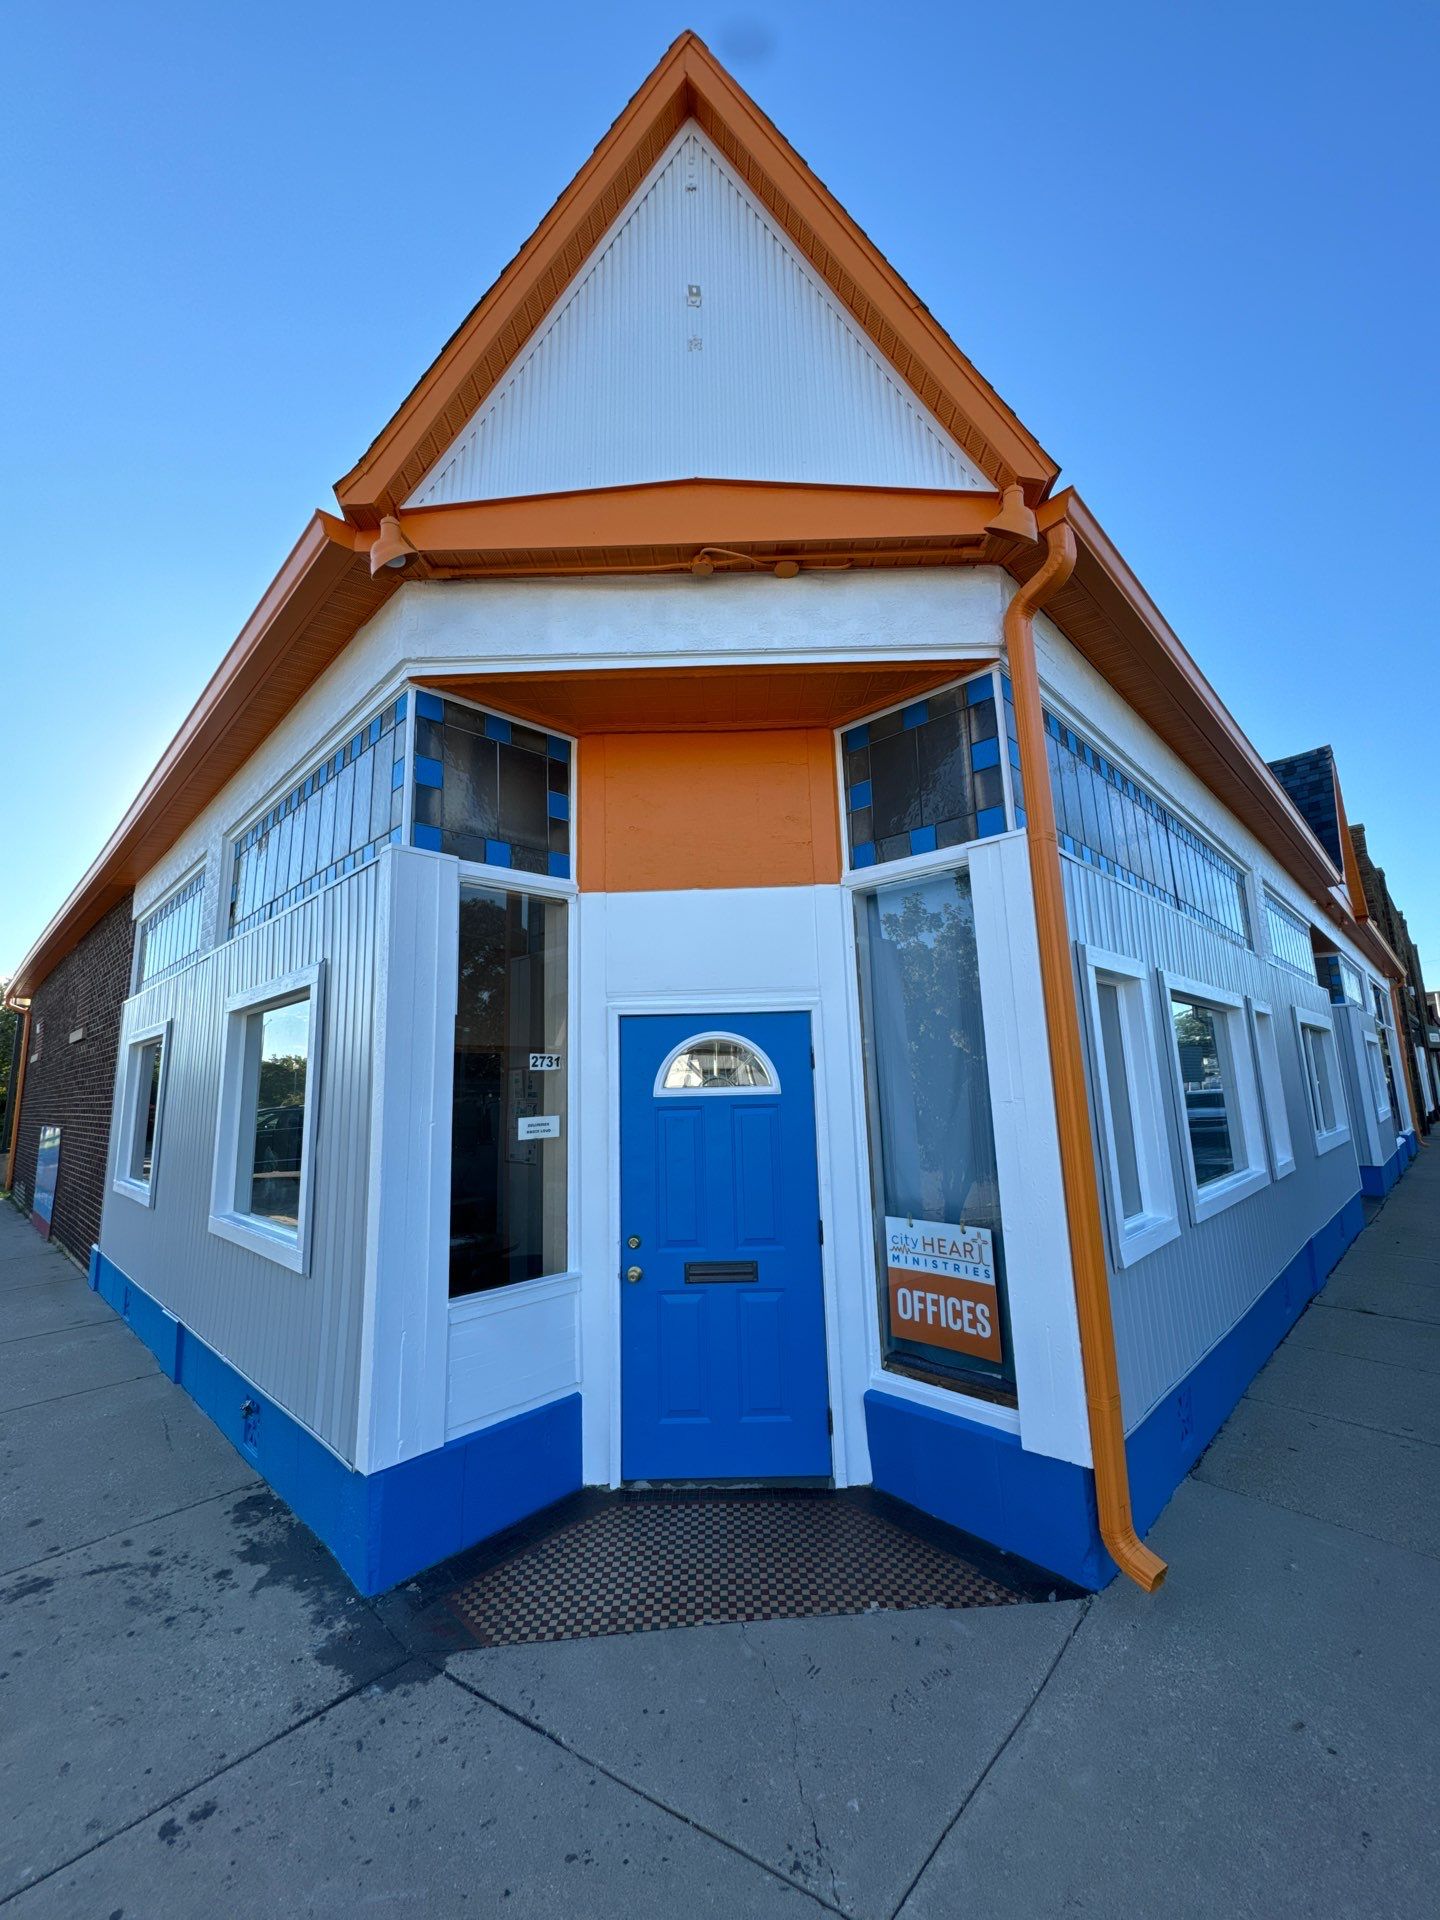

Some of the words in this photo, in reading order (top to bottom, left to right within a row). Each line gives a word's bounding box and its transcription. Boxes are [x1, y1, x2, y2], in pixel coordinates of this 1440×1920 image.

[531, 1055, 560, 1068] 2731
[891, 1233, 919, 1249] city
[892, 1254, 991, 1279] MINISTRIES
[897, 1287, 992, 1338] OFFICES
